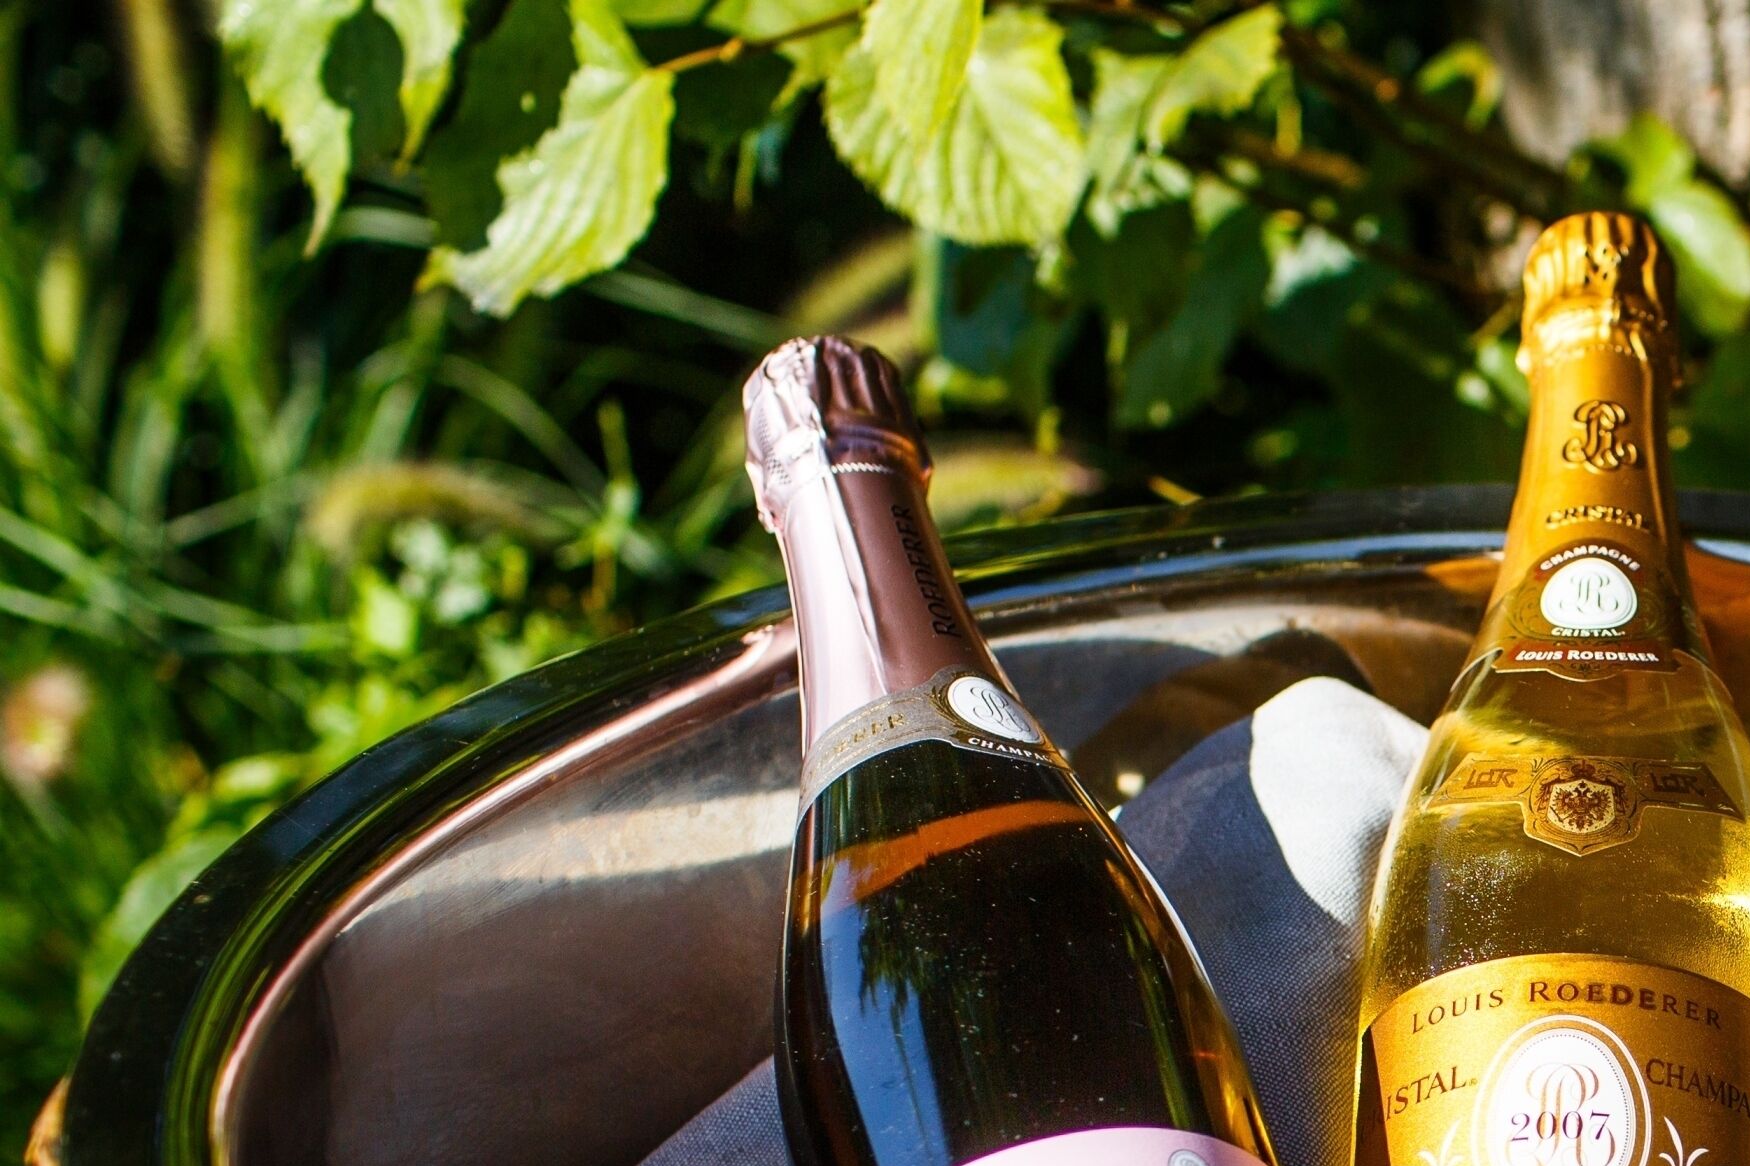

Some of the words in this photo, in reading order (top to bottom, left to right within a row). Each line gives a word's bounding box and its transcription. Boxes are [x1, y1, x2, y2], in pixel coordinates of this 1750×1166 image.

[891, 504, 962, 638] ROEDERER
[1540, 544, 1641, 571] CHAMPAGNE
[1515, 650, 1564, 661] LOUIS
[1567, 650, 1660, 662] ROEDERER
[1411, 988, 1505, 1035] LOUIS
[1528, 980, 1723, 1031] ROEDERER
[1510, 1109, 1611, 1142] 2007
